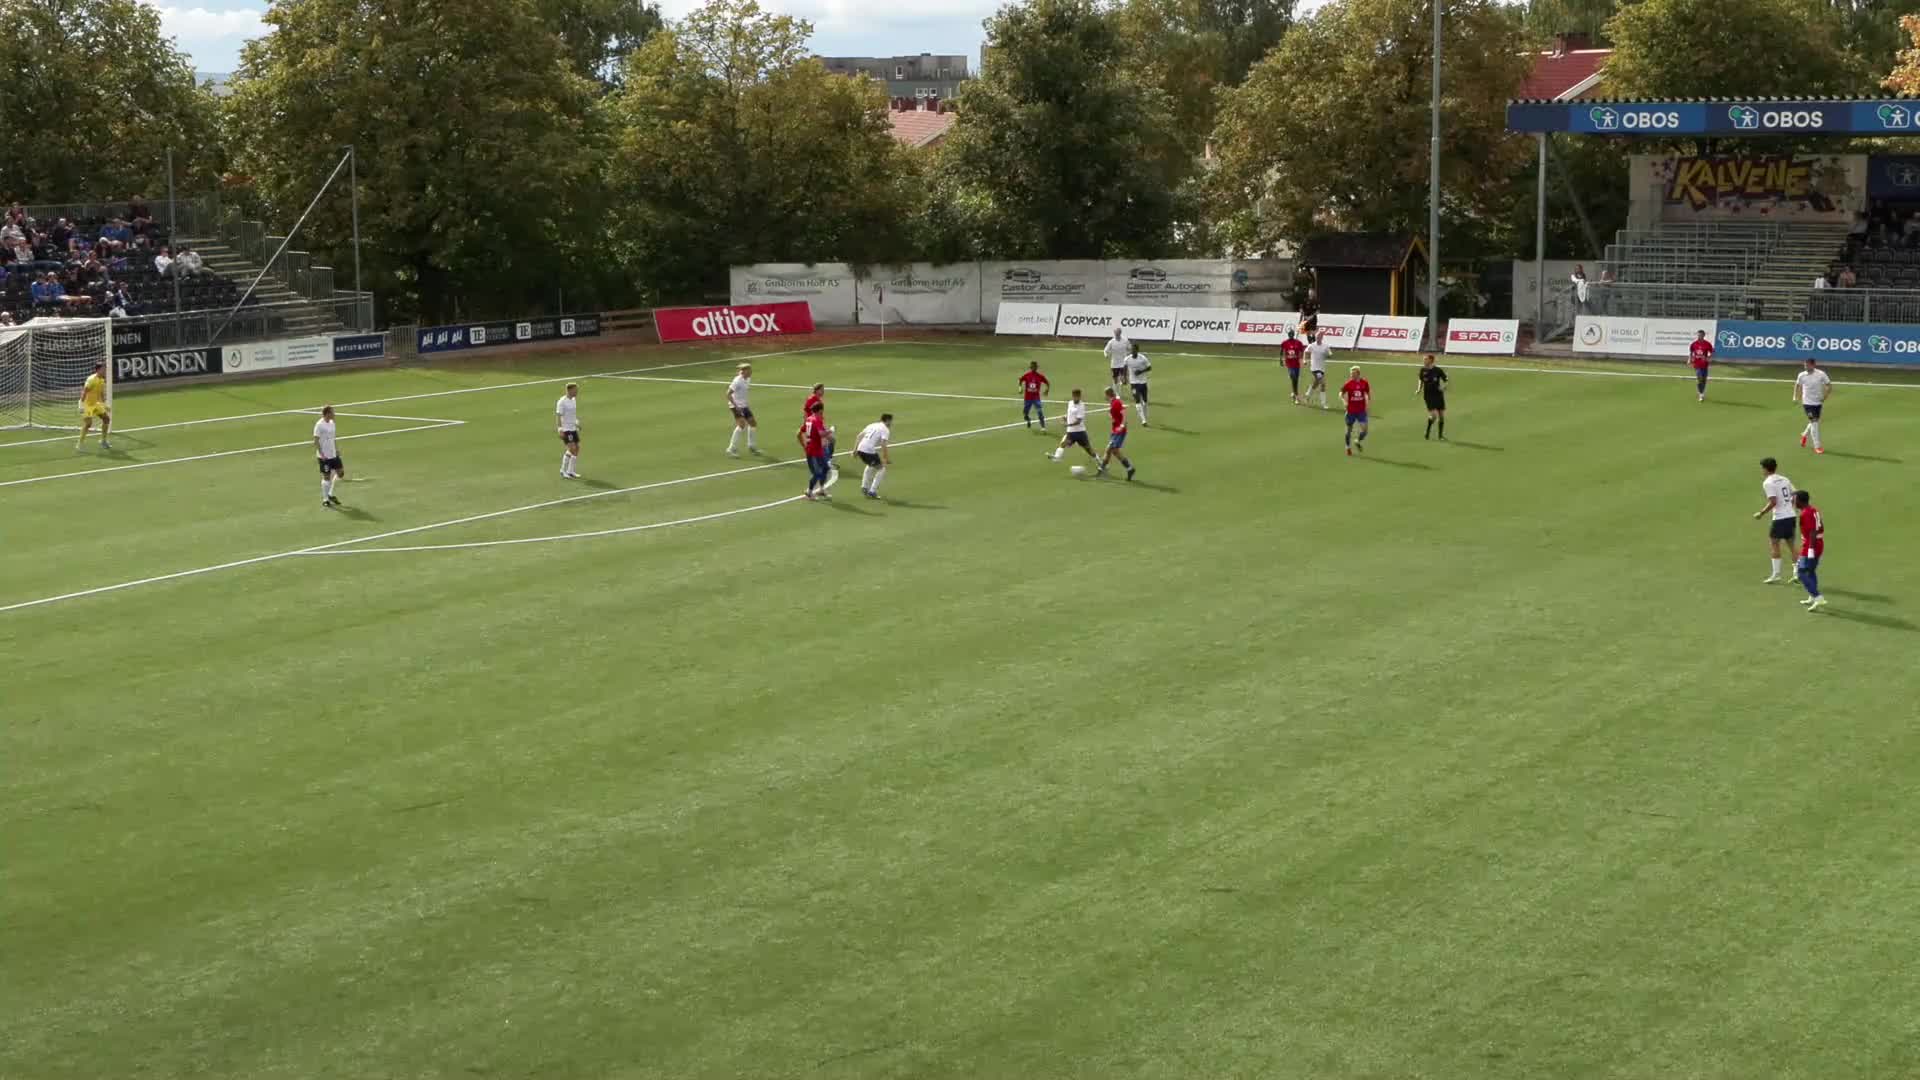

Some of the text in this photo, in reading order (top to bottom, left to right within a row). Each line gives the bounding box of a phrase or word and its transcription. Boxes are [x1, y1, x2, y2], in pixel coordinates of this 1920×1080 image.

[1623, 112, 1679, 128] OBOS
[1763, 111, 1823, 128] OBOS
[1671, 159, 1810, 210] KALVENE
[1001, 283, 1036, 292] Castor
[1127, 282, 1162, 290] Castor
[692, 308, 781, 337] altibox
[1246, 322, 1283, 333] SPAR
[1371, 328, 1408, 338] SPAR
[1458, 332, 1500, 341] SPAR
[1743, 335, 1786, 348] OBOS
[1817, 338, 1861, 351] OBOS
[1894, 340, 1920, 353] OB
[117, 351, 208, 379] PRINSEN
